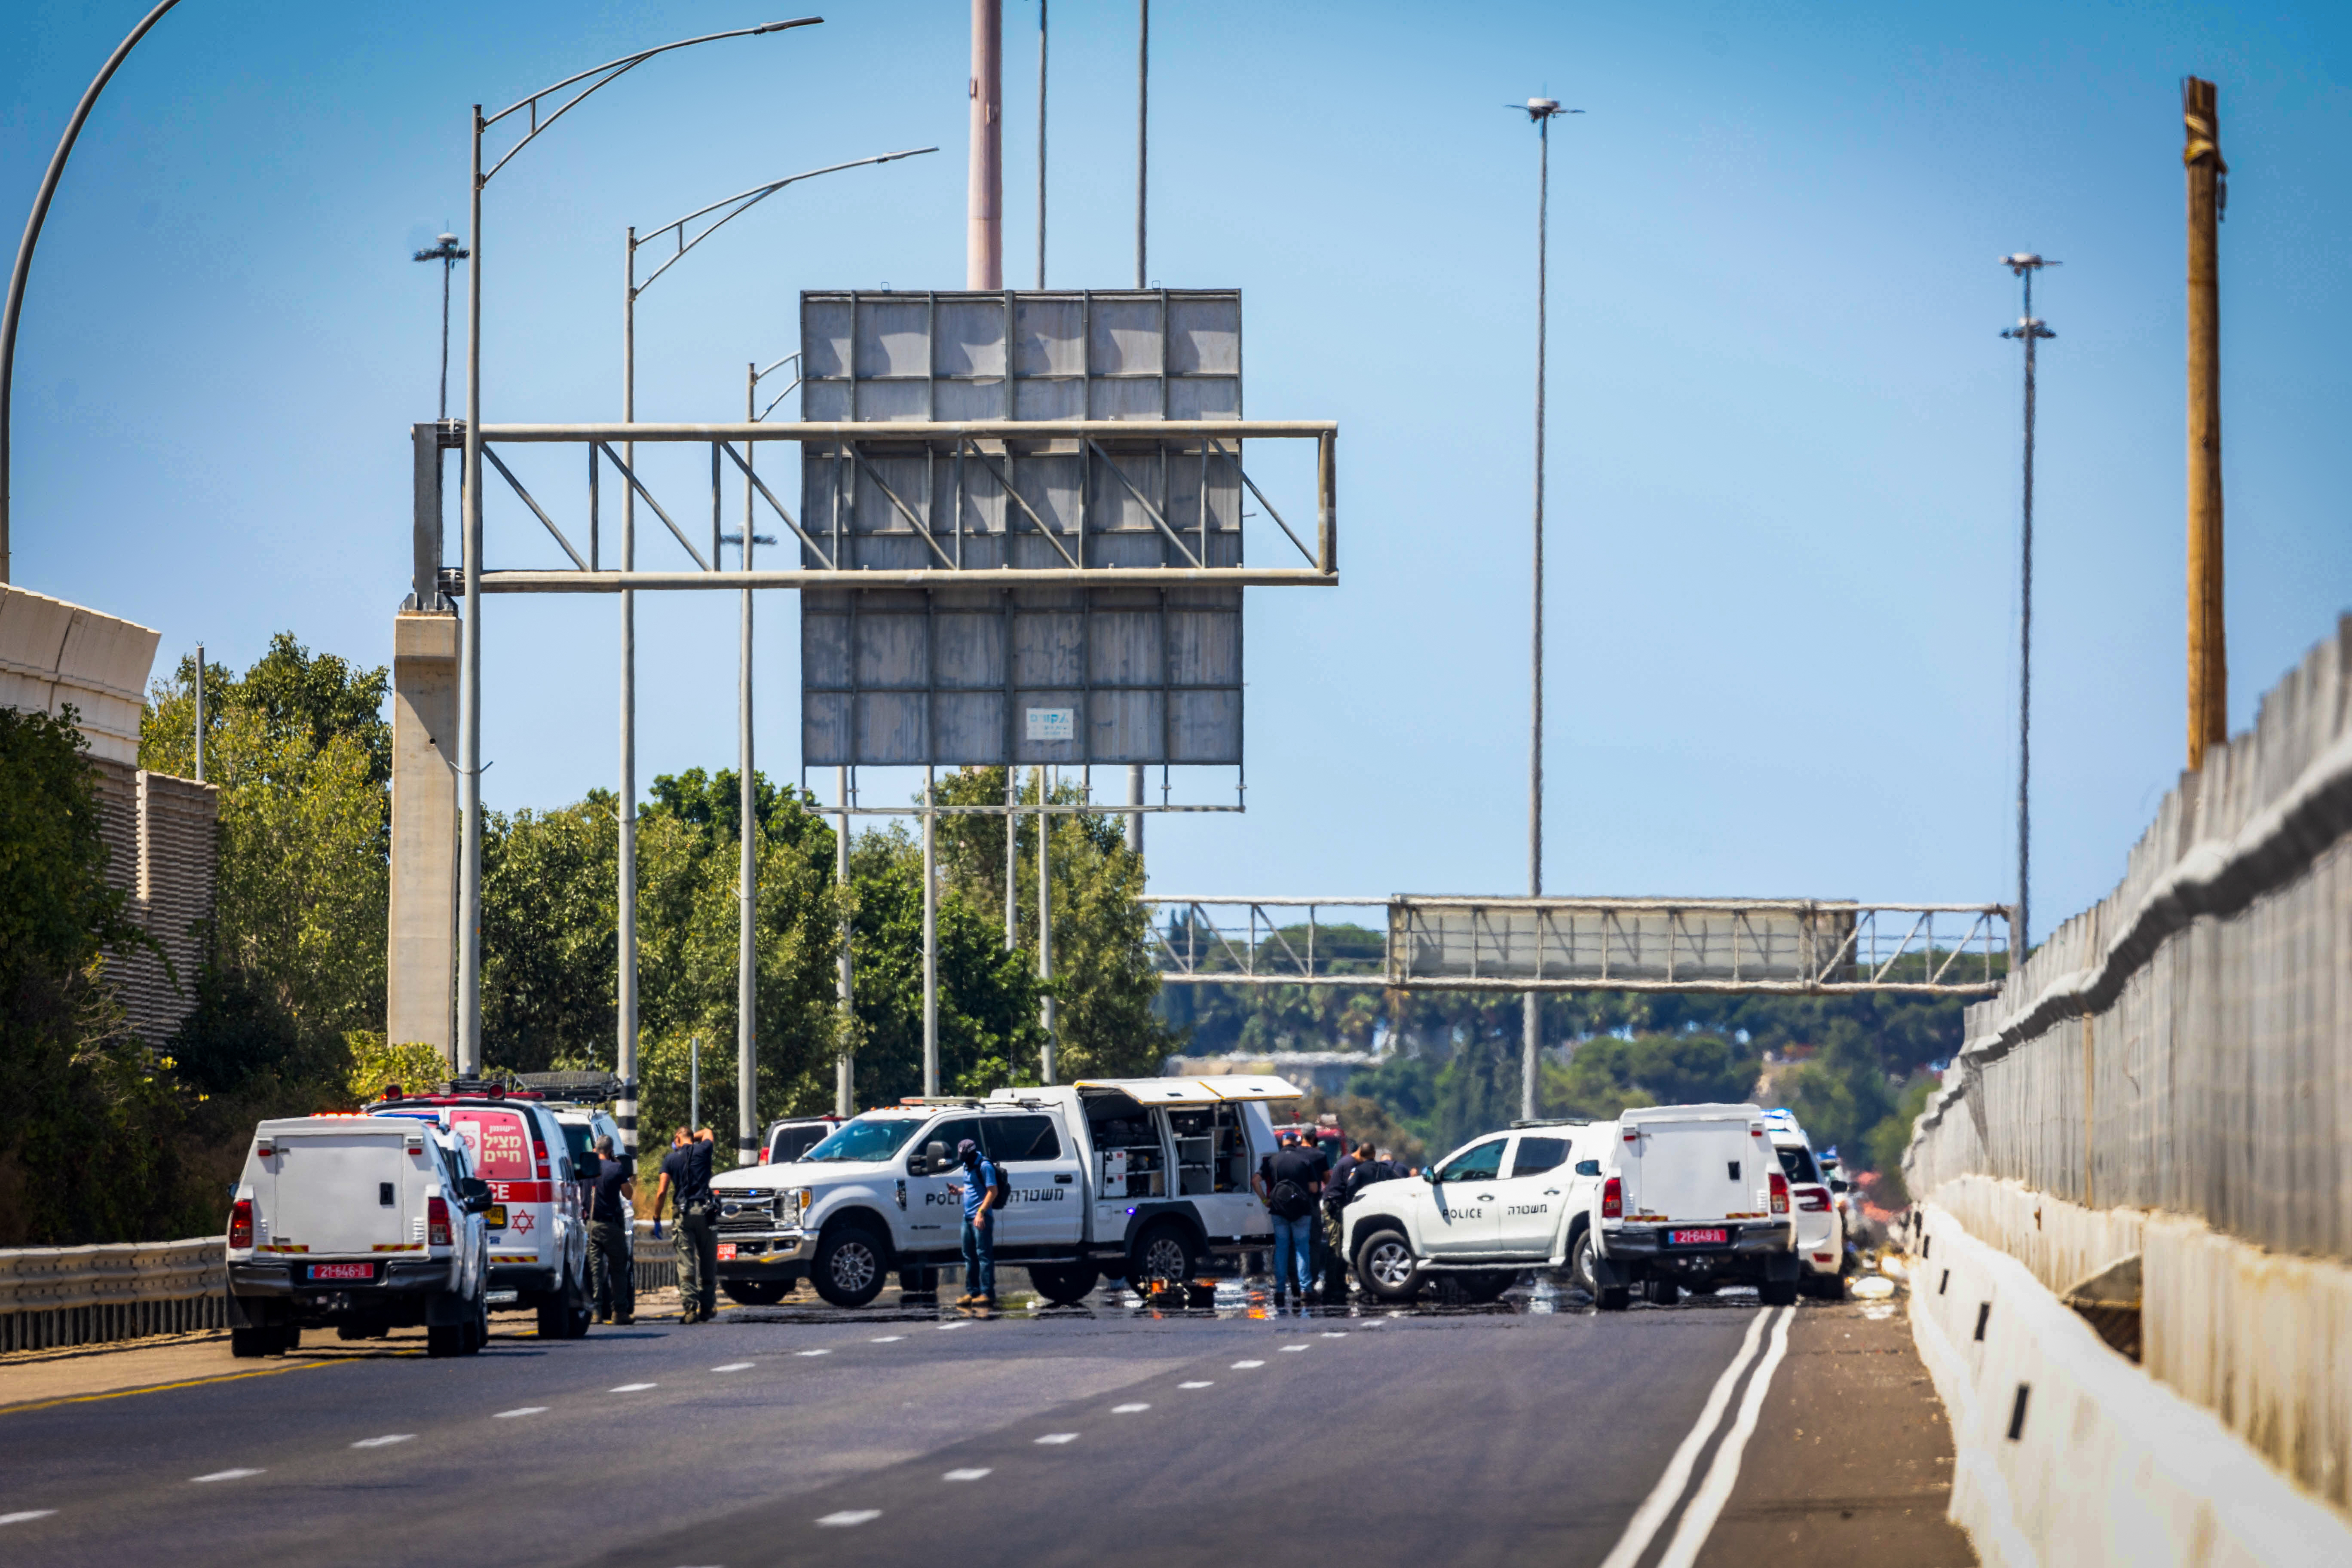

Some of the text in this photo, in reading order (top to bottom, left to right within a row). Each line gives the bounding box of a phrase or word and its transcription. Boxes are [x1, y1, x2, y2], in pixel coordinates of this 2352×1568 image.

[483, 1133, 521, 1148] מציל
[484, 1150, 521, 1162] חיים
[487, 1183, 510, 1199] CE
[1009, 1188, 1064, 1203] משטרה
[926, 1193, 961, 1206] POLI
[1442, 1208, 1482, 1219] POLICE
[1508, 1204, 1547, 1216] משטרה
